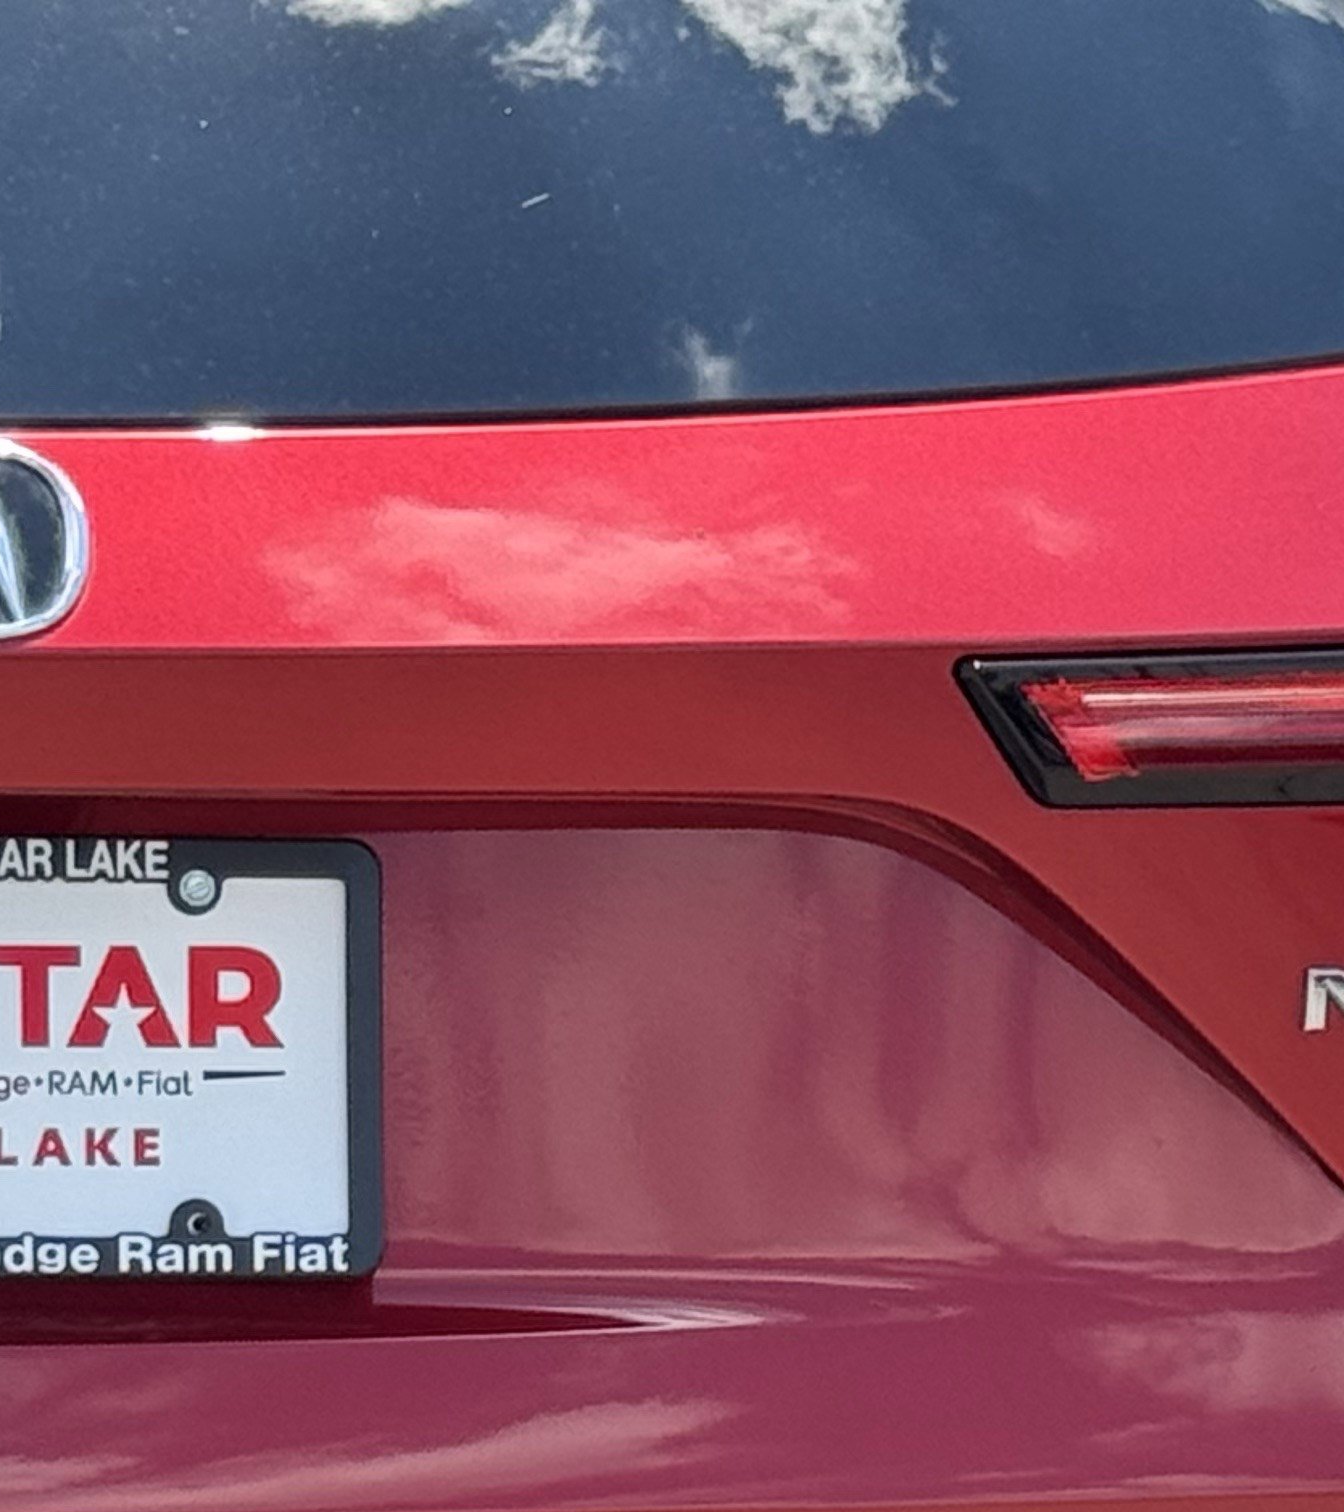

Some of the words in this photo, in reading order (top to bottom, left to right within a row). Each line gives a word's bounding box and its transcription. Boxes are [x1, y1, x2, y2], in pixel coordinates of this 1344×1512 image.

[64, 839, 170, 880] LAKE
[47, 1070, 118, 1096] RAM
[137, 1069, 193, 1097] Fiat
[117, 1235, 233, 1273] Ram
[252, 1233, 349, 1273] Fiat
